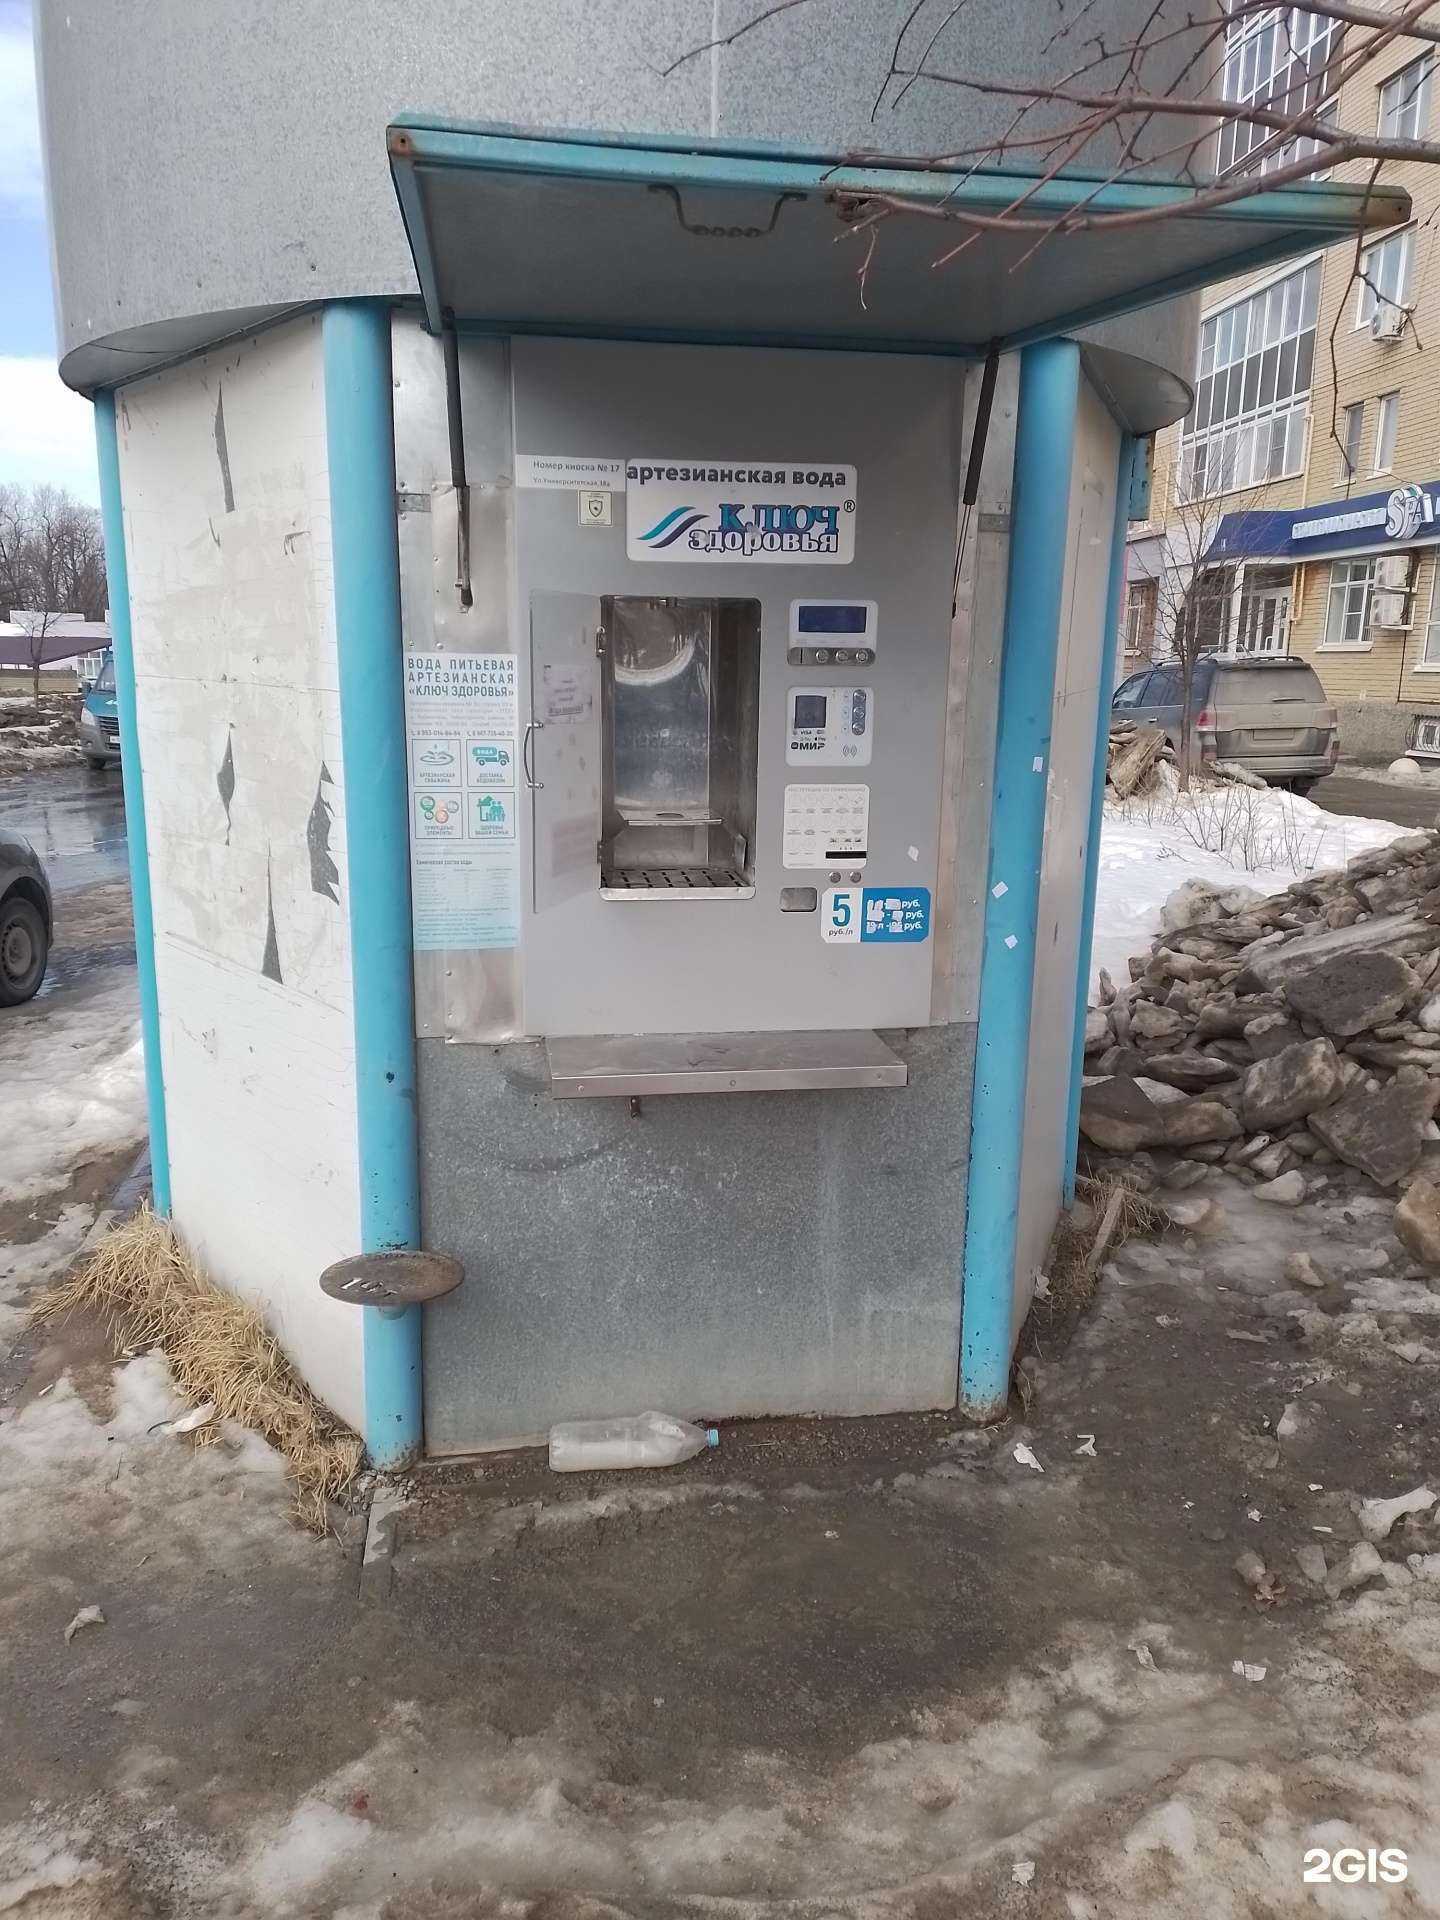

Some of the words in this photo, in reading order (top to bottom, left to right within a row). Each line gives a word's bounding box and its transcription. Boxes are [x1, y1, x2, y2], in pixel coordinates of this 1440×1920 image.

[533, 460, 563, 471] Номер
[565, 463, 595, 472] киоска
[597, 464, 608, 472] №
[610, 465, 620, 473] 17
[626, 465, 786, 485] артезианская
[792, 469, 846, 488] вода
[408, 658, 441, 671] ВОДА
[450, 659, 514, 671] ПИТЬЕВАЯ
[408, 672, 514, 684] АРТЕЗИАНСКАЯ
[800, 742, 826, 750] МИР
[832, 894, 850, 926] 5
[902, 899, 920, 909] руб.
[906, 910, 924, 920] руб.
[904, 922, 922, 931] руб.
